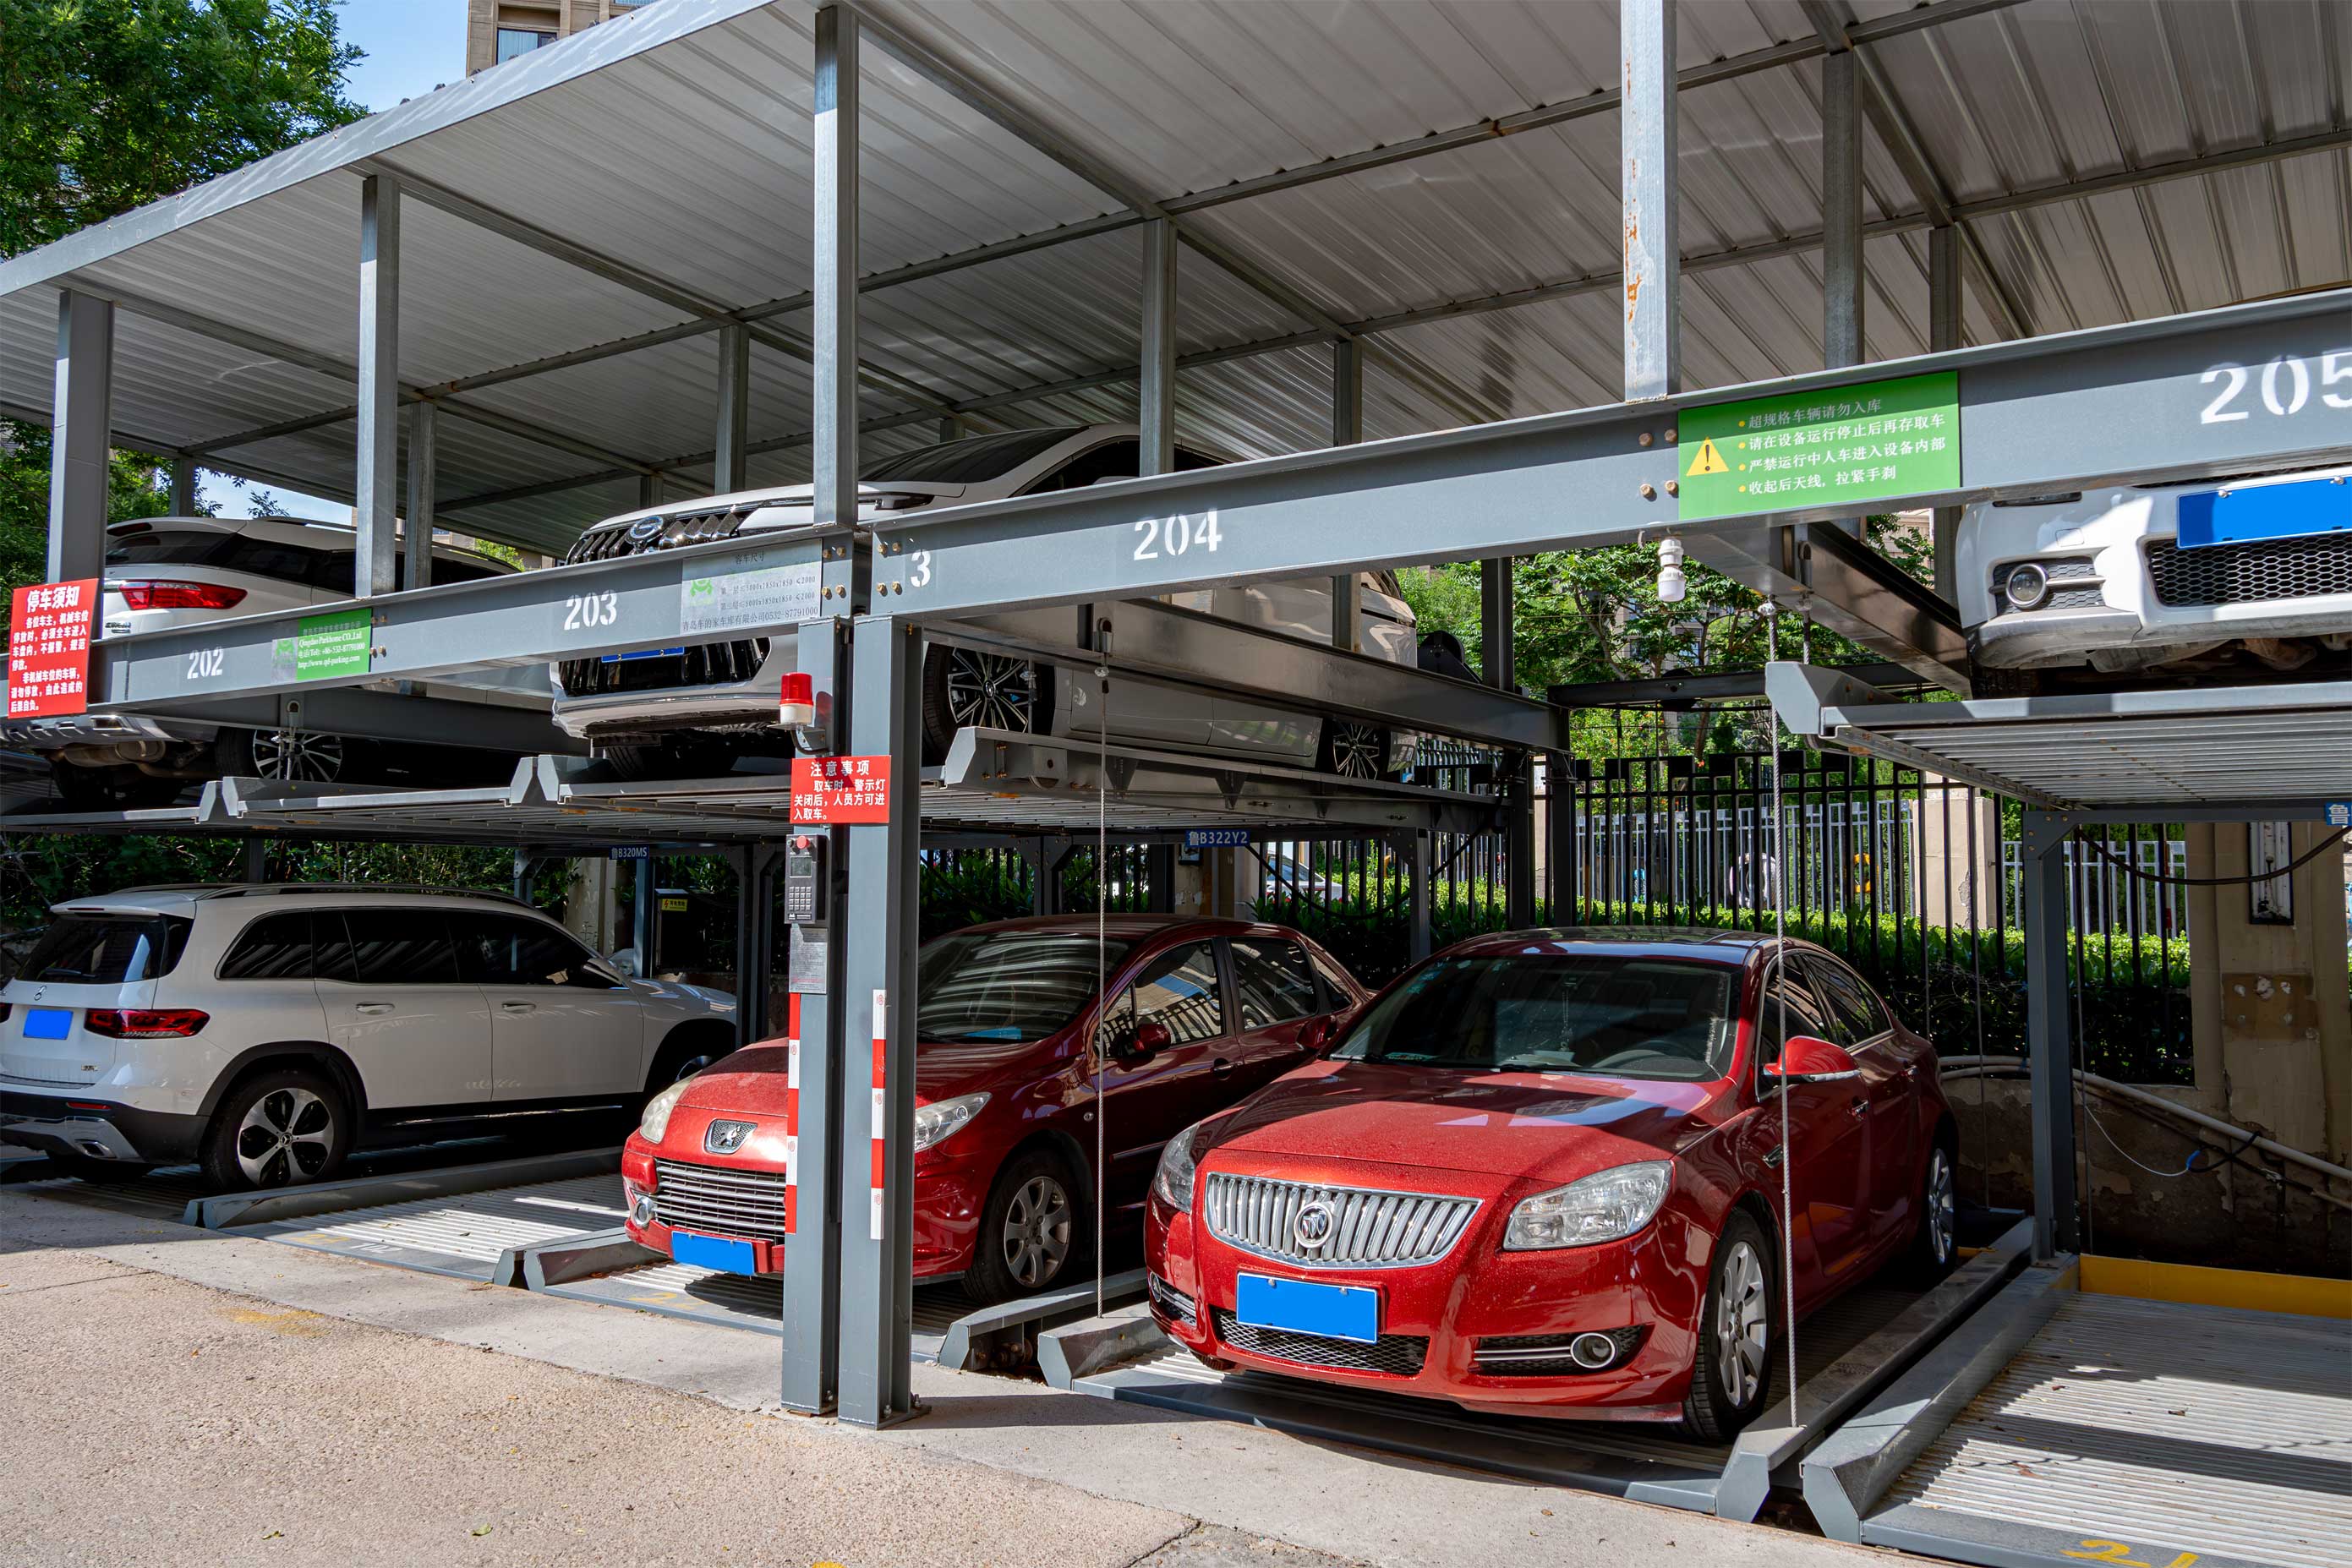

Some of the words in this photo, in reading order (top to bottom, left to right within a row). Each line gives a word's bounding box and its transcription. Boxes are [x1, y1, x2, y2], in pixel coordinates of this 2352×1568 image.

[2200, 347, 2352, 424] 205
[1748, 398, 1881, 429] 超规格车辆请勿入库
[1748, 412, 1945, 451] 请在设备运行停止后再存取车
[1748, 436, 1946, 473] 严禁运行中人车进入设备内部
[1133, 508, 1223, 560] 204
[910, 549, 931, 587] 3
[26, 585, 80, 613] 停车须知
[564, 589, 617, 631] 203
[187, 646, 224, 680] 202
[810, 760, 870, 777] 注意事项
[794, 793, 885, 806] 关闭后，人员方可进
[813, 779, 886, 792] 取车时，警示灯
[793, 808, 828, 820] 入取车。
[2327, 804, 2351, 825] 鲁
[1189, 831, 1248, 846] 鲁B322Y2
[611, 847, 648, 860] 鲁B320MS
